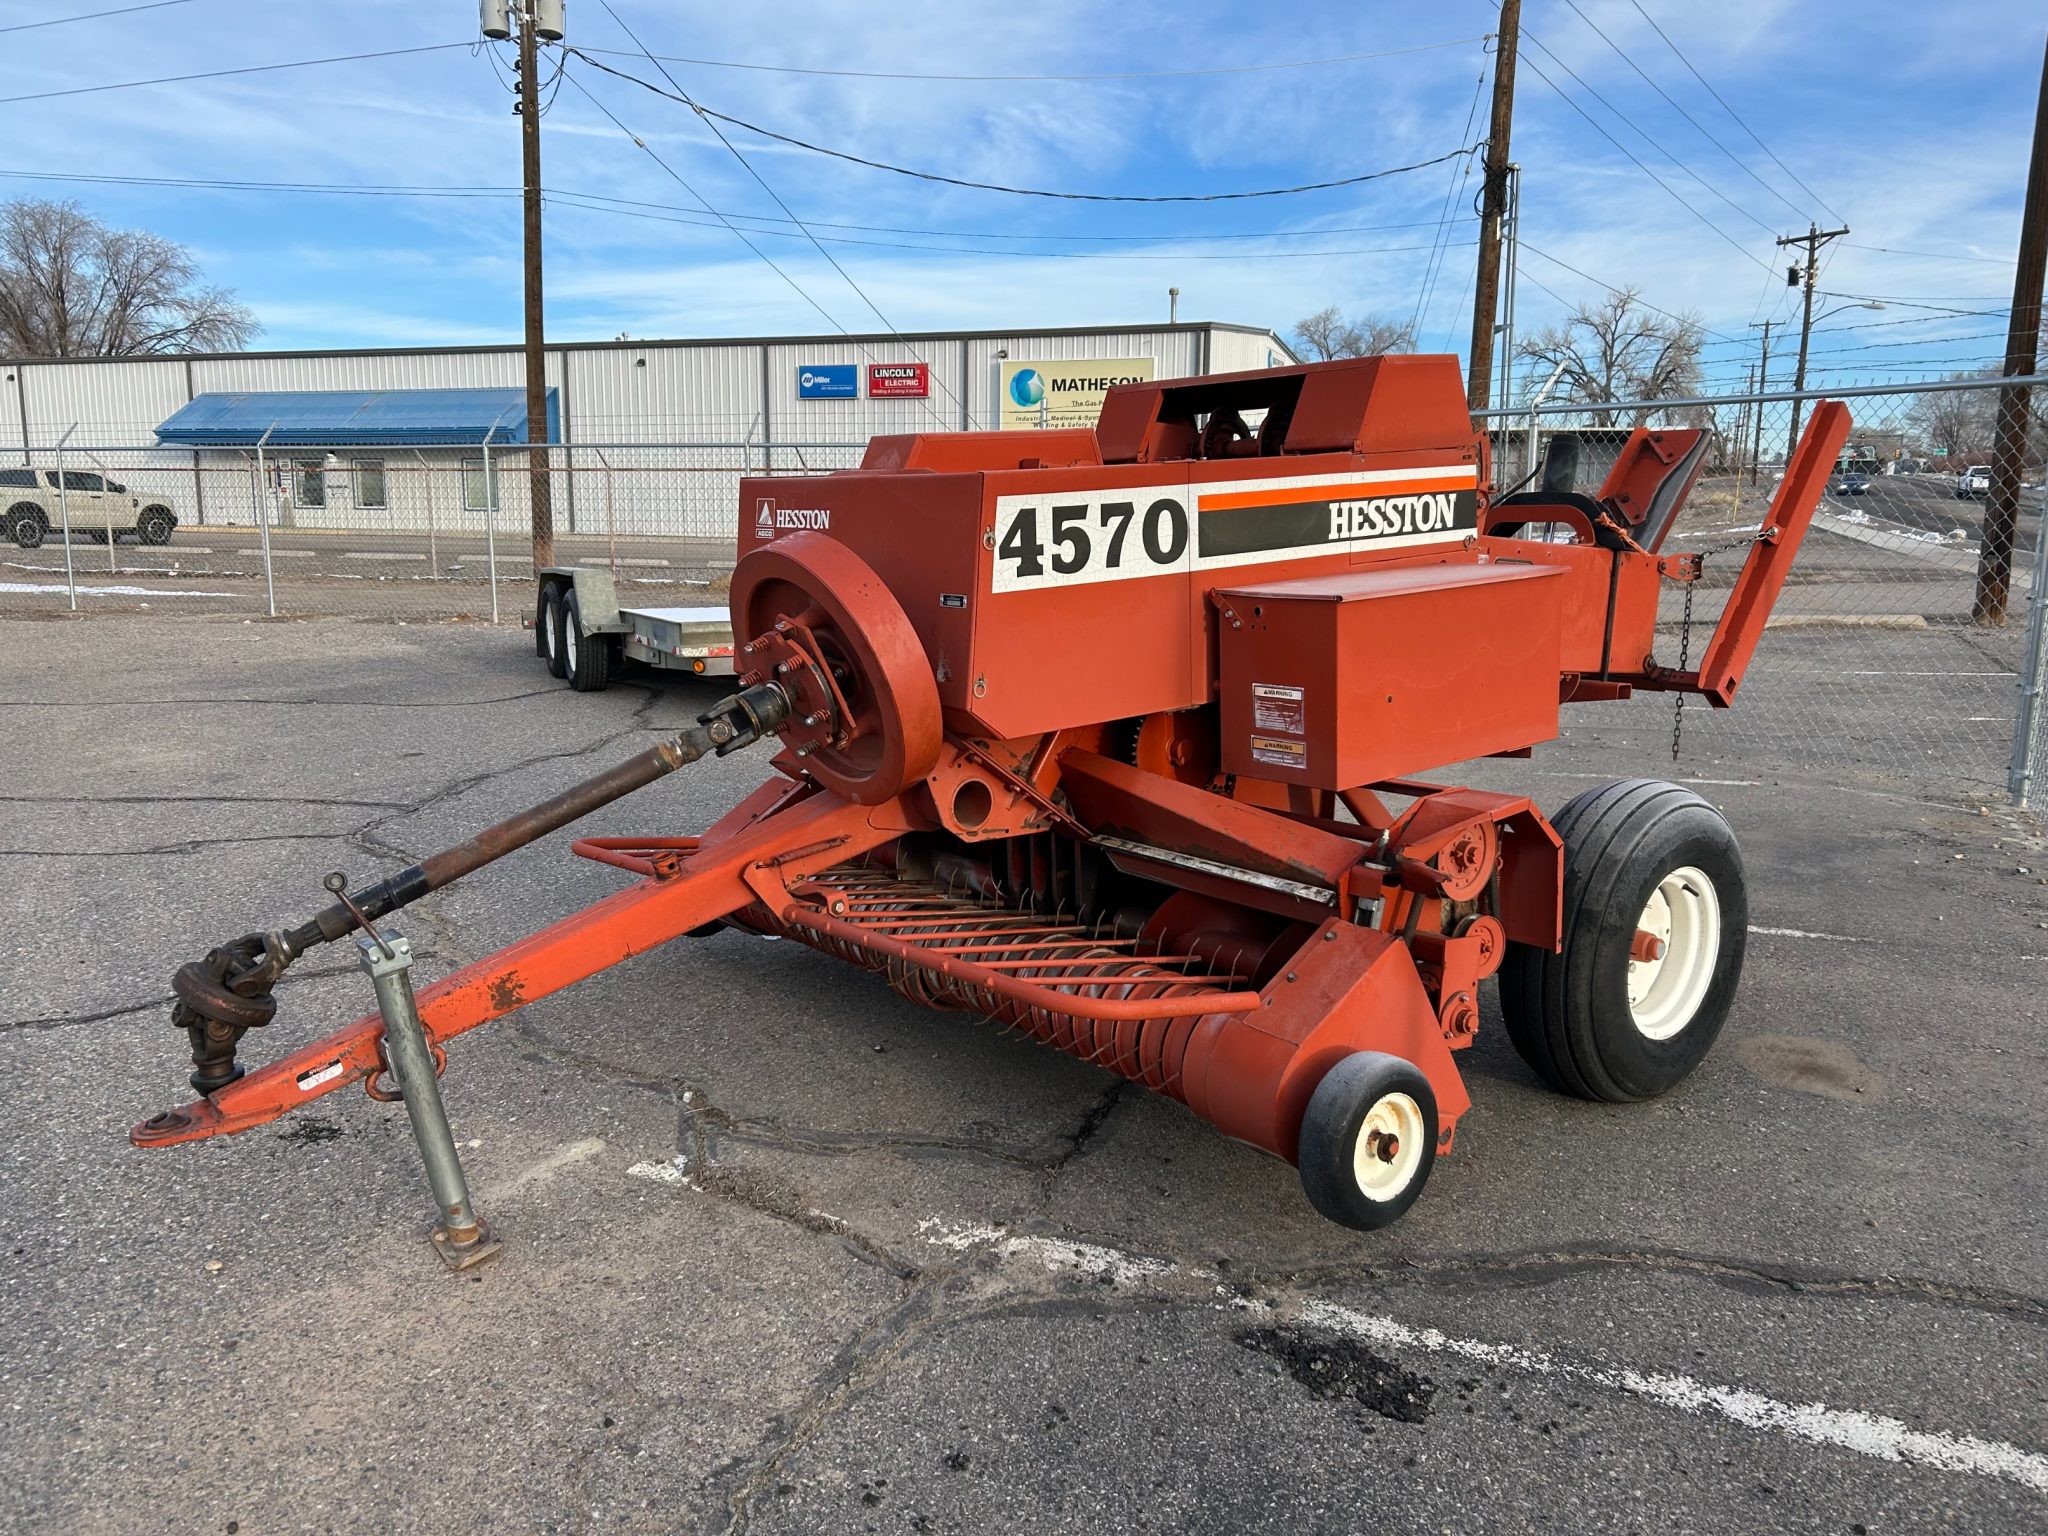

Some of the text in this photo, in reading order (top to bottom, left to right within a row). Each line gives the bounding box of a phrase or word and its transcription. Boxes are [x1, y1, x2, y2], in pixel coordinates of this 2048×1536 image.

[875, 368, 914, 378] LINCOLN
[813, 376, 831, 384] Miller
[884, 379, 920, 387] ELECTRIC
[776, 509, 831, 530] HESSTON
[1328, 493, 1457, 540] HESSTON
[999, 498, 1188, 578] 4570
[1267, 689, 1293, 698] WARNING
[1267, 743, 1293, 751] WARNING
